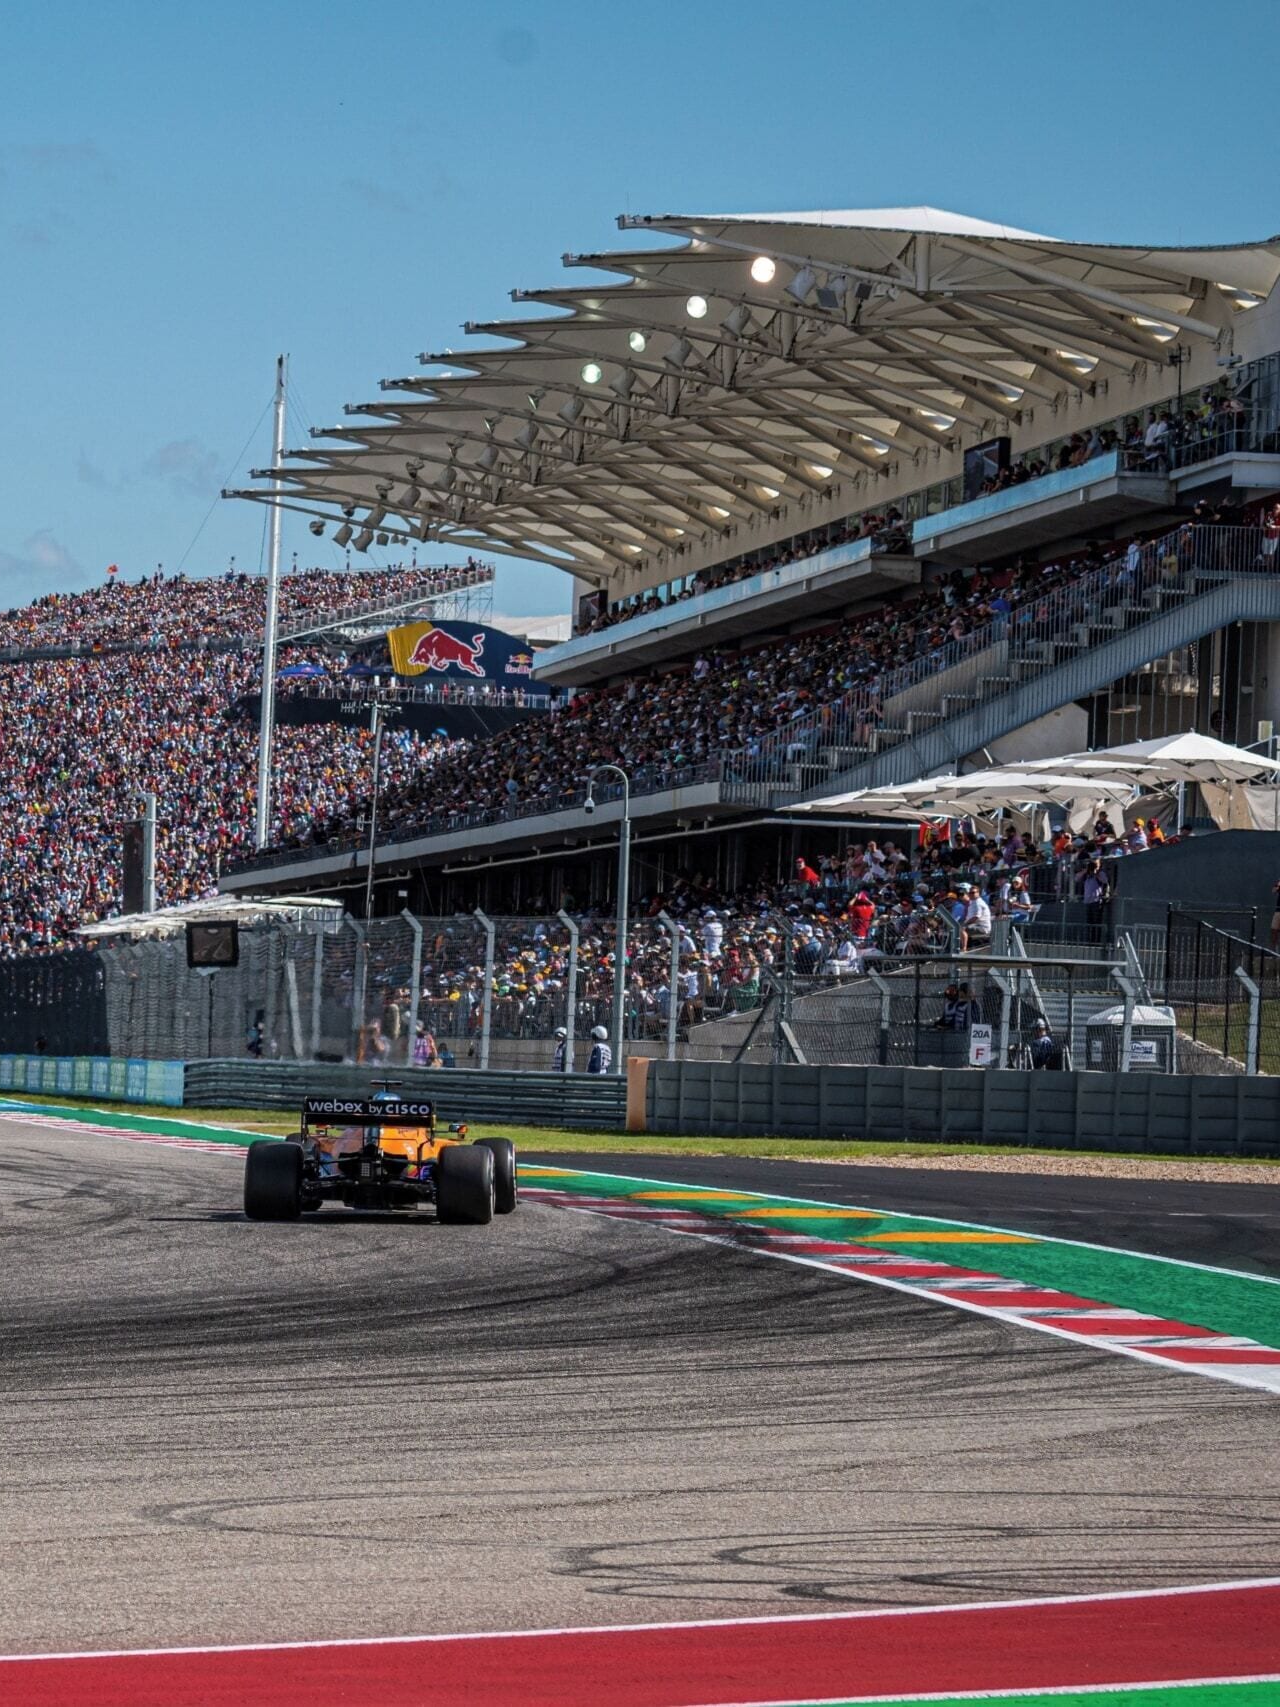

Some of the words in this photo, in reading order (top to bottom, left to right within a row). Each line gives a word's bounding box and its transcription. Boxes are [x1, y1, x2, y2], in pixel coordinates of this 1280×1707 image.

[972, 1030, 990, 1039] 20A
[975, 1048, 985, 1060] F
[308, 1099, 363, 1113] webex
[369, 1103, 383, 1116] by
